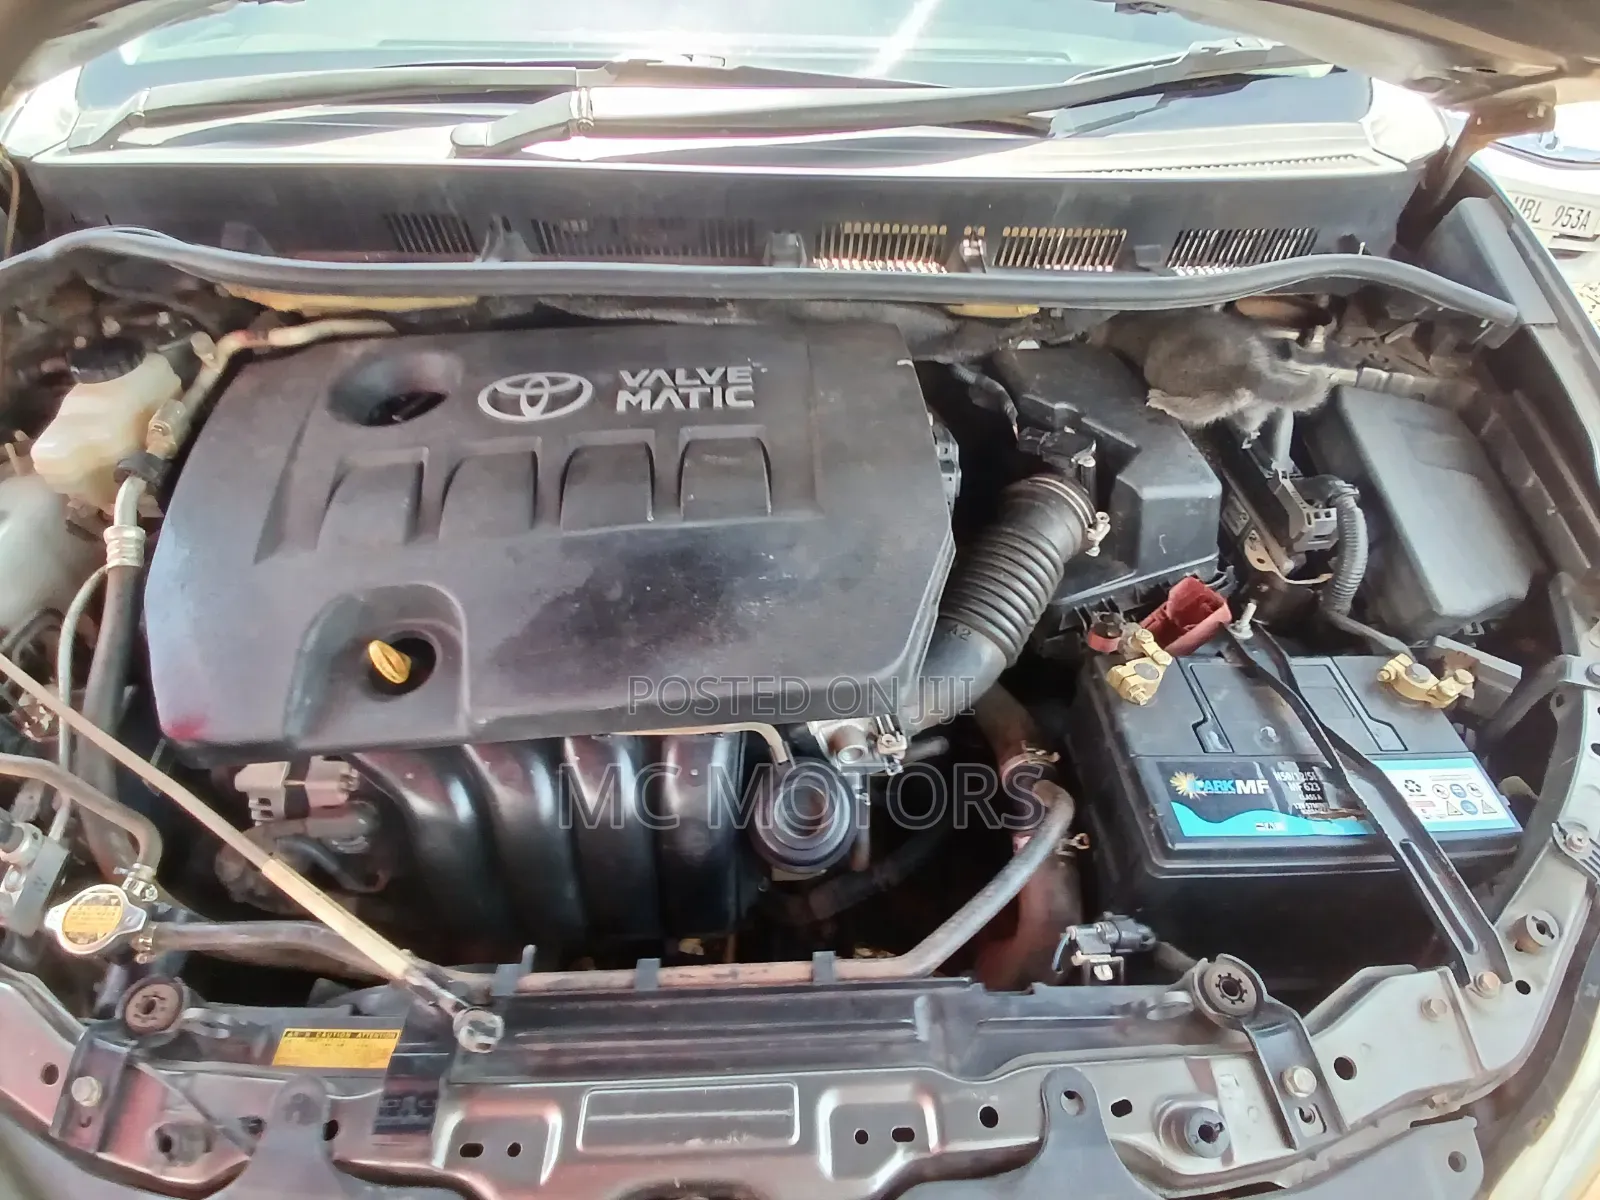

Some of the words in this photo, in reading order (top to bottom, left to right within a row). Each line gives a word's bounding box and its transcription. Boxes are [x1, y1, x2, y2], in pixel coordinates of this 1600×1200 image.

[1551, 205, 1592, 231] 953A
[619, 366, 753, 388] VALVE
[616, 386, 755, 412] MATIC
[1303, 782, 1321, 792] 623
[316, 1031, 352, 1039] CAUTION
